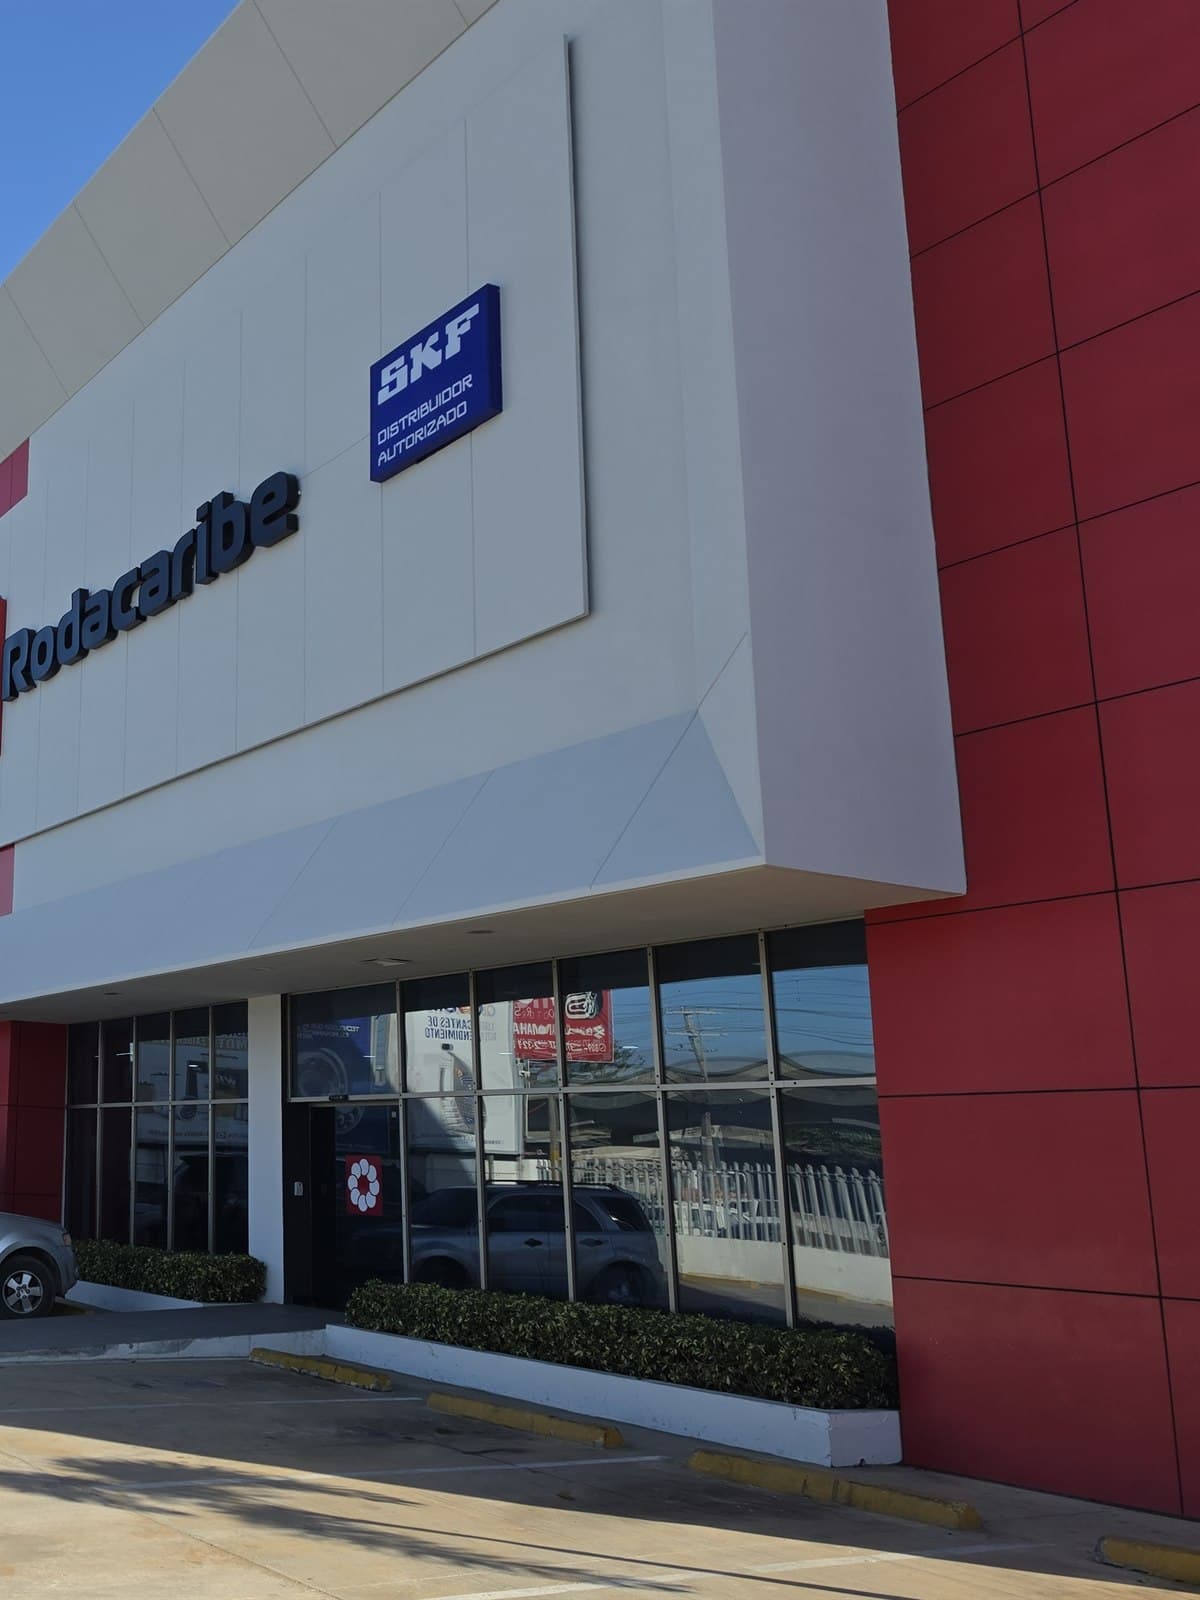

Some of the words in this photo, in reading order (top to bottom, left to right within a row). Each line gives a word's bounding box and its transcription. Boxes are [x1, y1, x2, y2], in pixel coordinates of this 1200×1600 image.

[378, 303, 479, 405] SKF
[378, 374, 473, 445] DISTRIBUIDOR
[378, 400, 467, 467] AUTORIZADO
[2, 471, 301, 702] Rodacaribe
